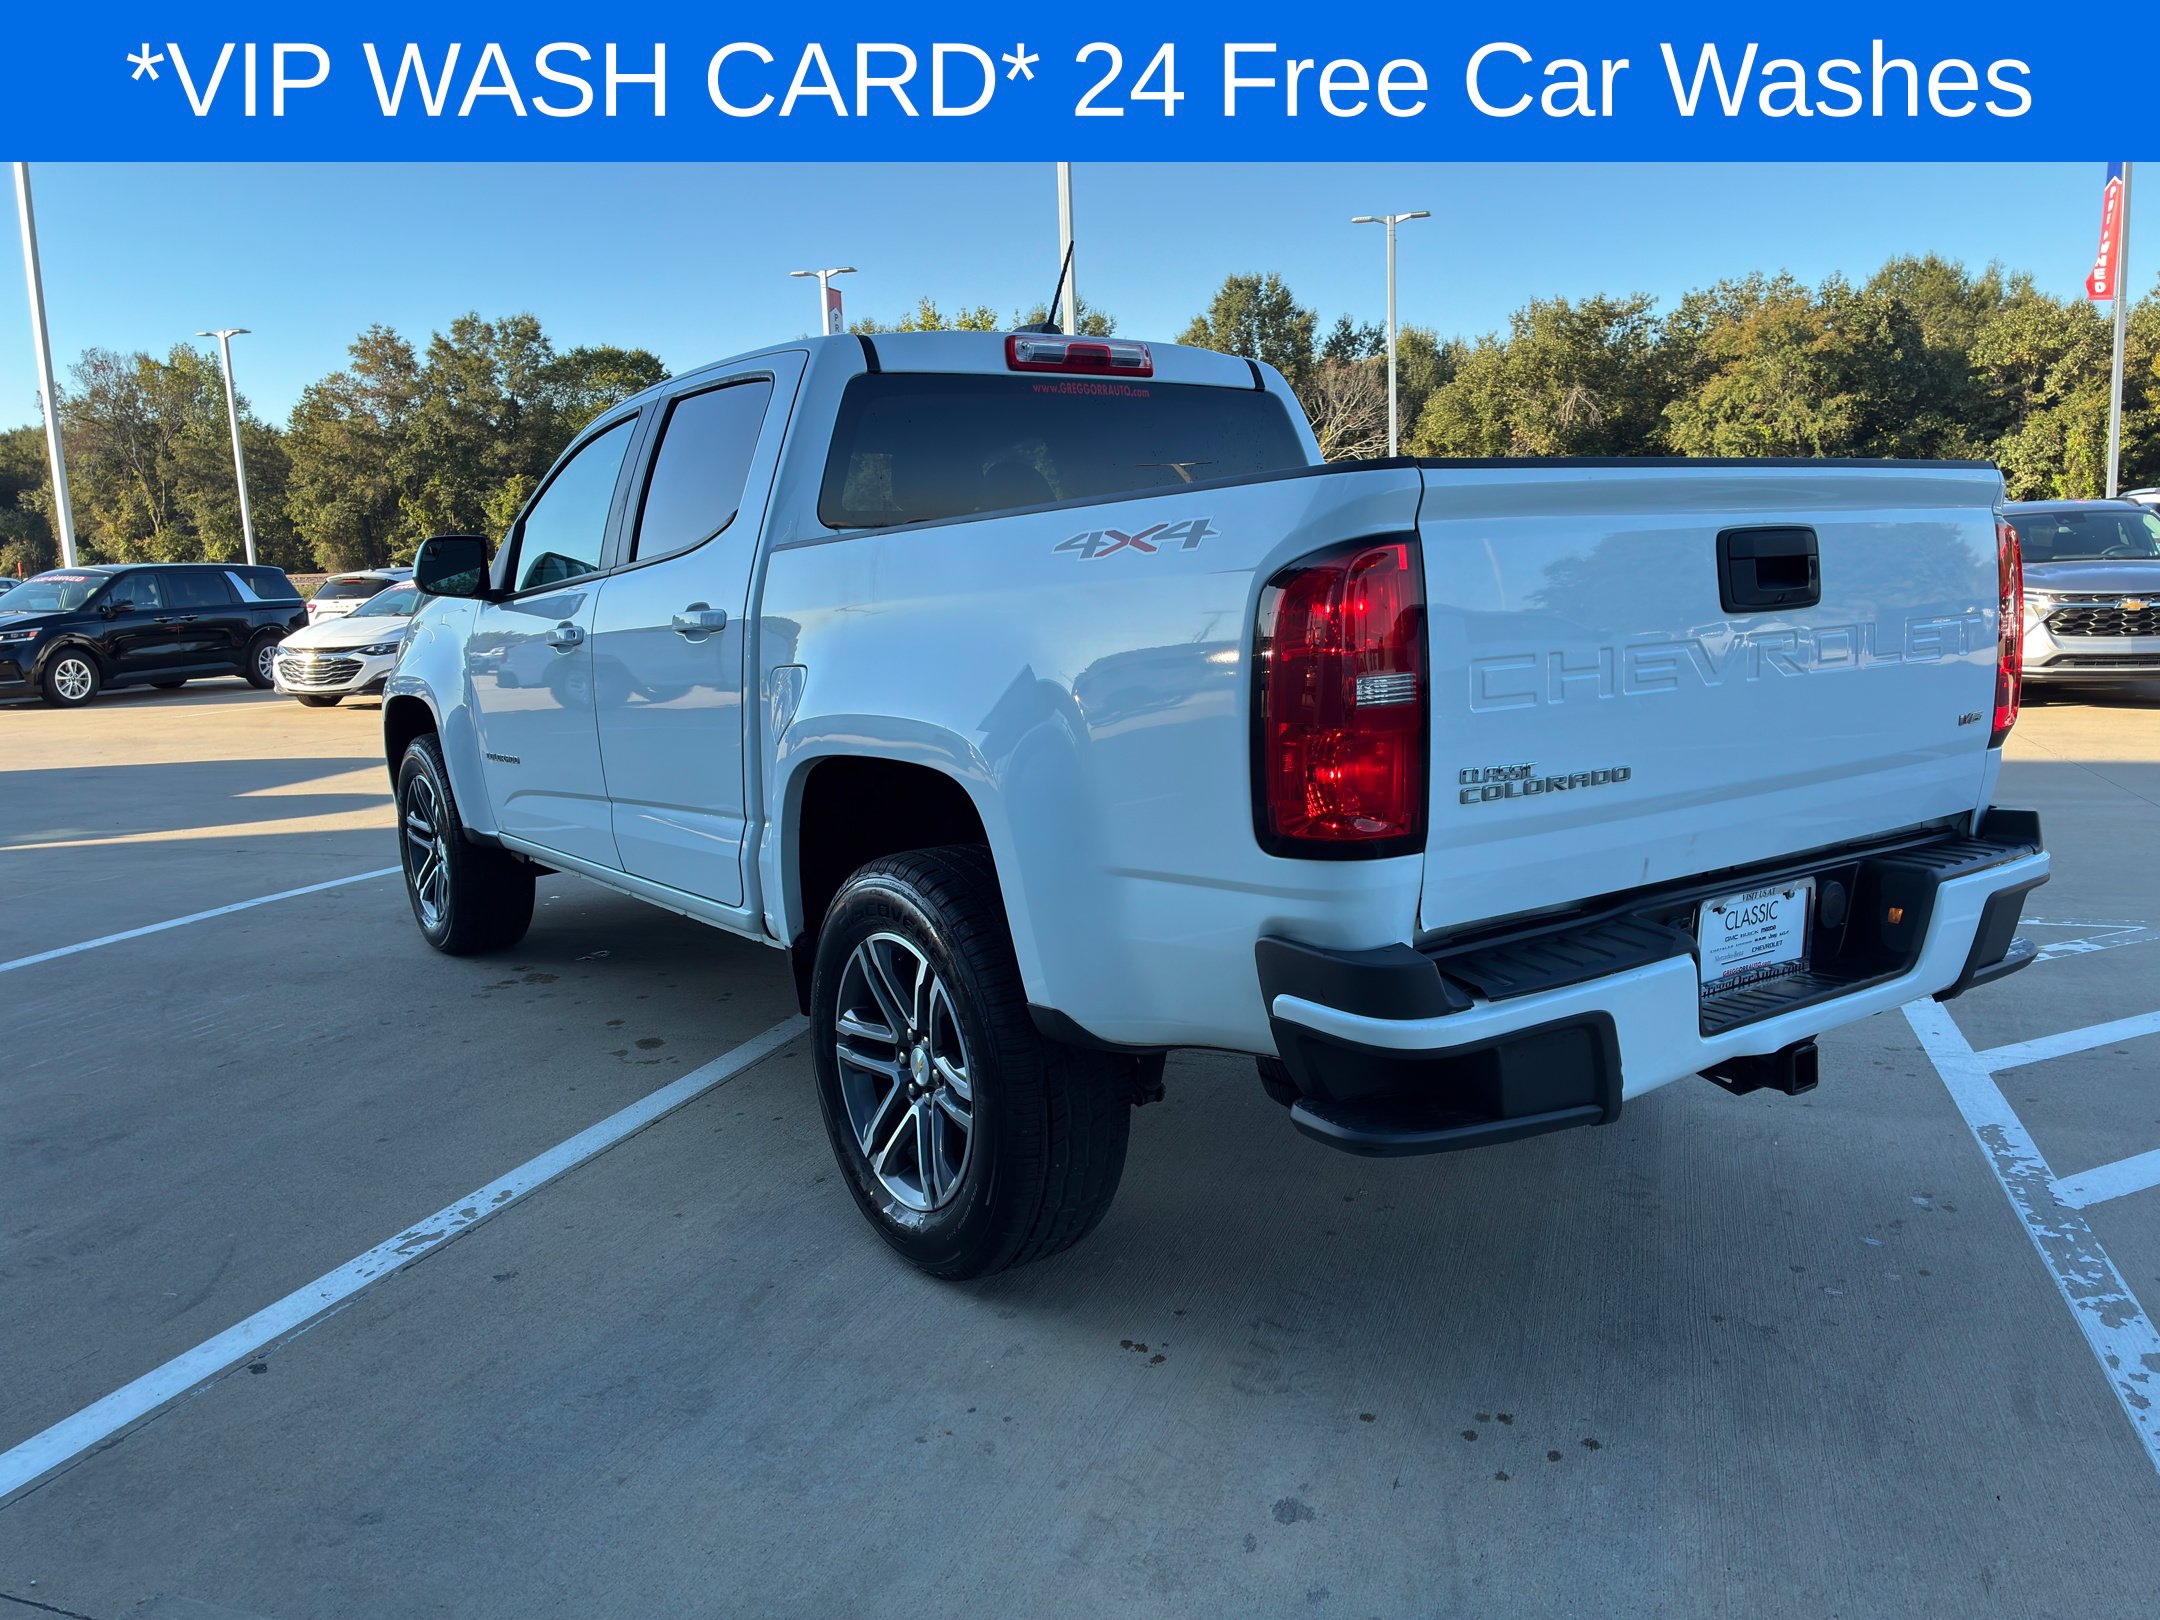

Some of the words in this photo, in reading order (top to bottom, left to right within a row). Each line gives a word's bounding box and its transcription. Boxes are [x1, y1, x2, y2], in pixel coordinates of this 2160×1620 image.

[1033, 382, 1150, 398] www.GREGGORRAUTO.com
[1469, 611, 1982, 714] CHEVROLET
[1459, 761, 1539, 785] CLASSIC
[1459, 765, 1632, 805] COLORADO
[1742, 892, 1758, 902] VISIT
[1725, 900, 1779, 931] CLASSIC
[1724, 934, 1739, 943] GMC
[1740, 930, 1759, 938] BUICK
[1751, 940, 1783, 953] CHEVROLET
